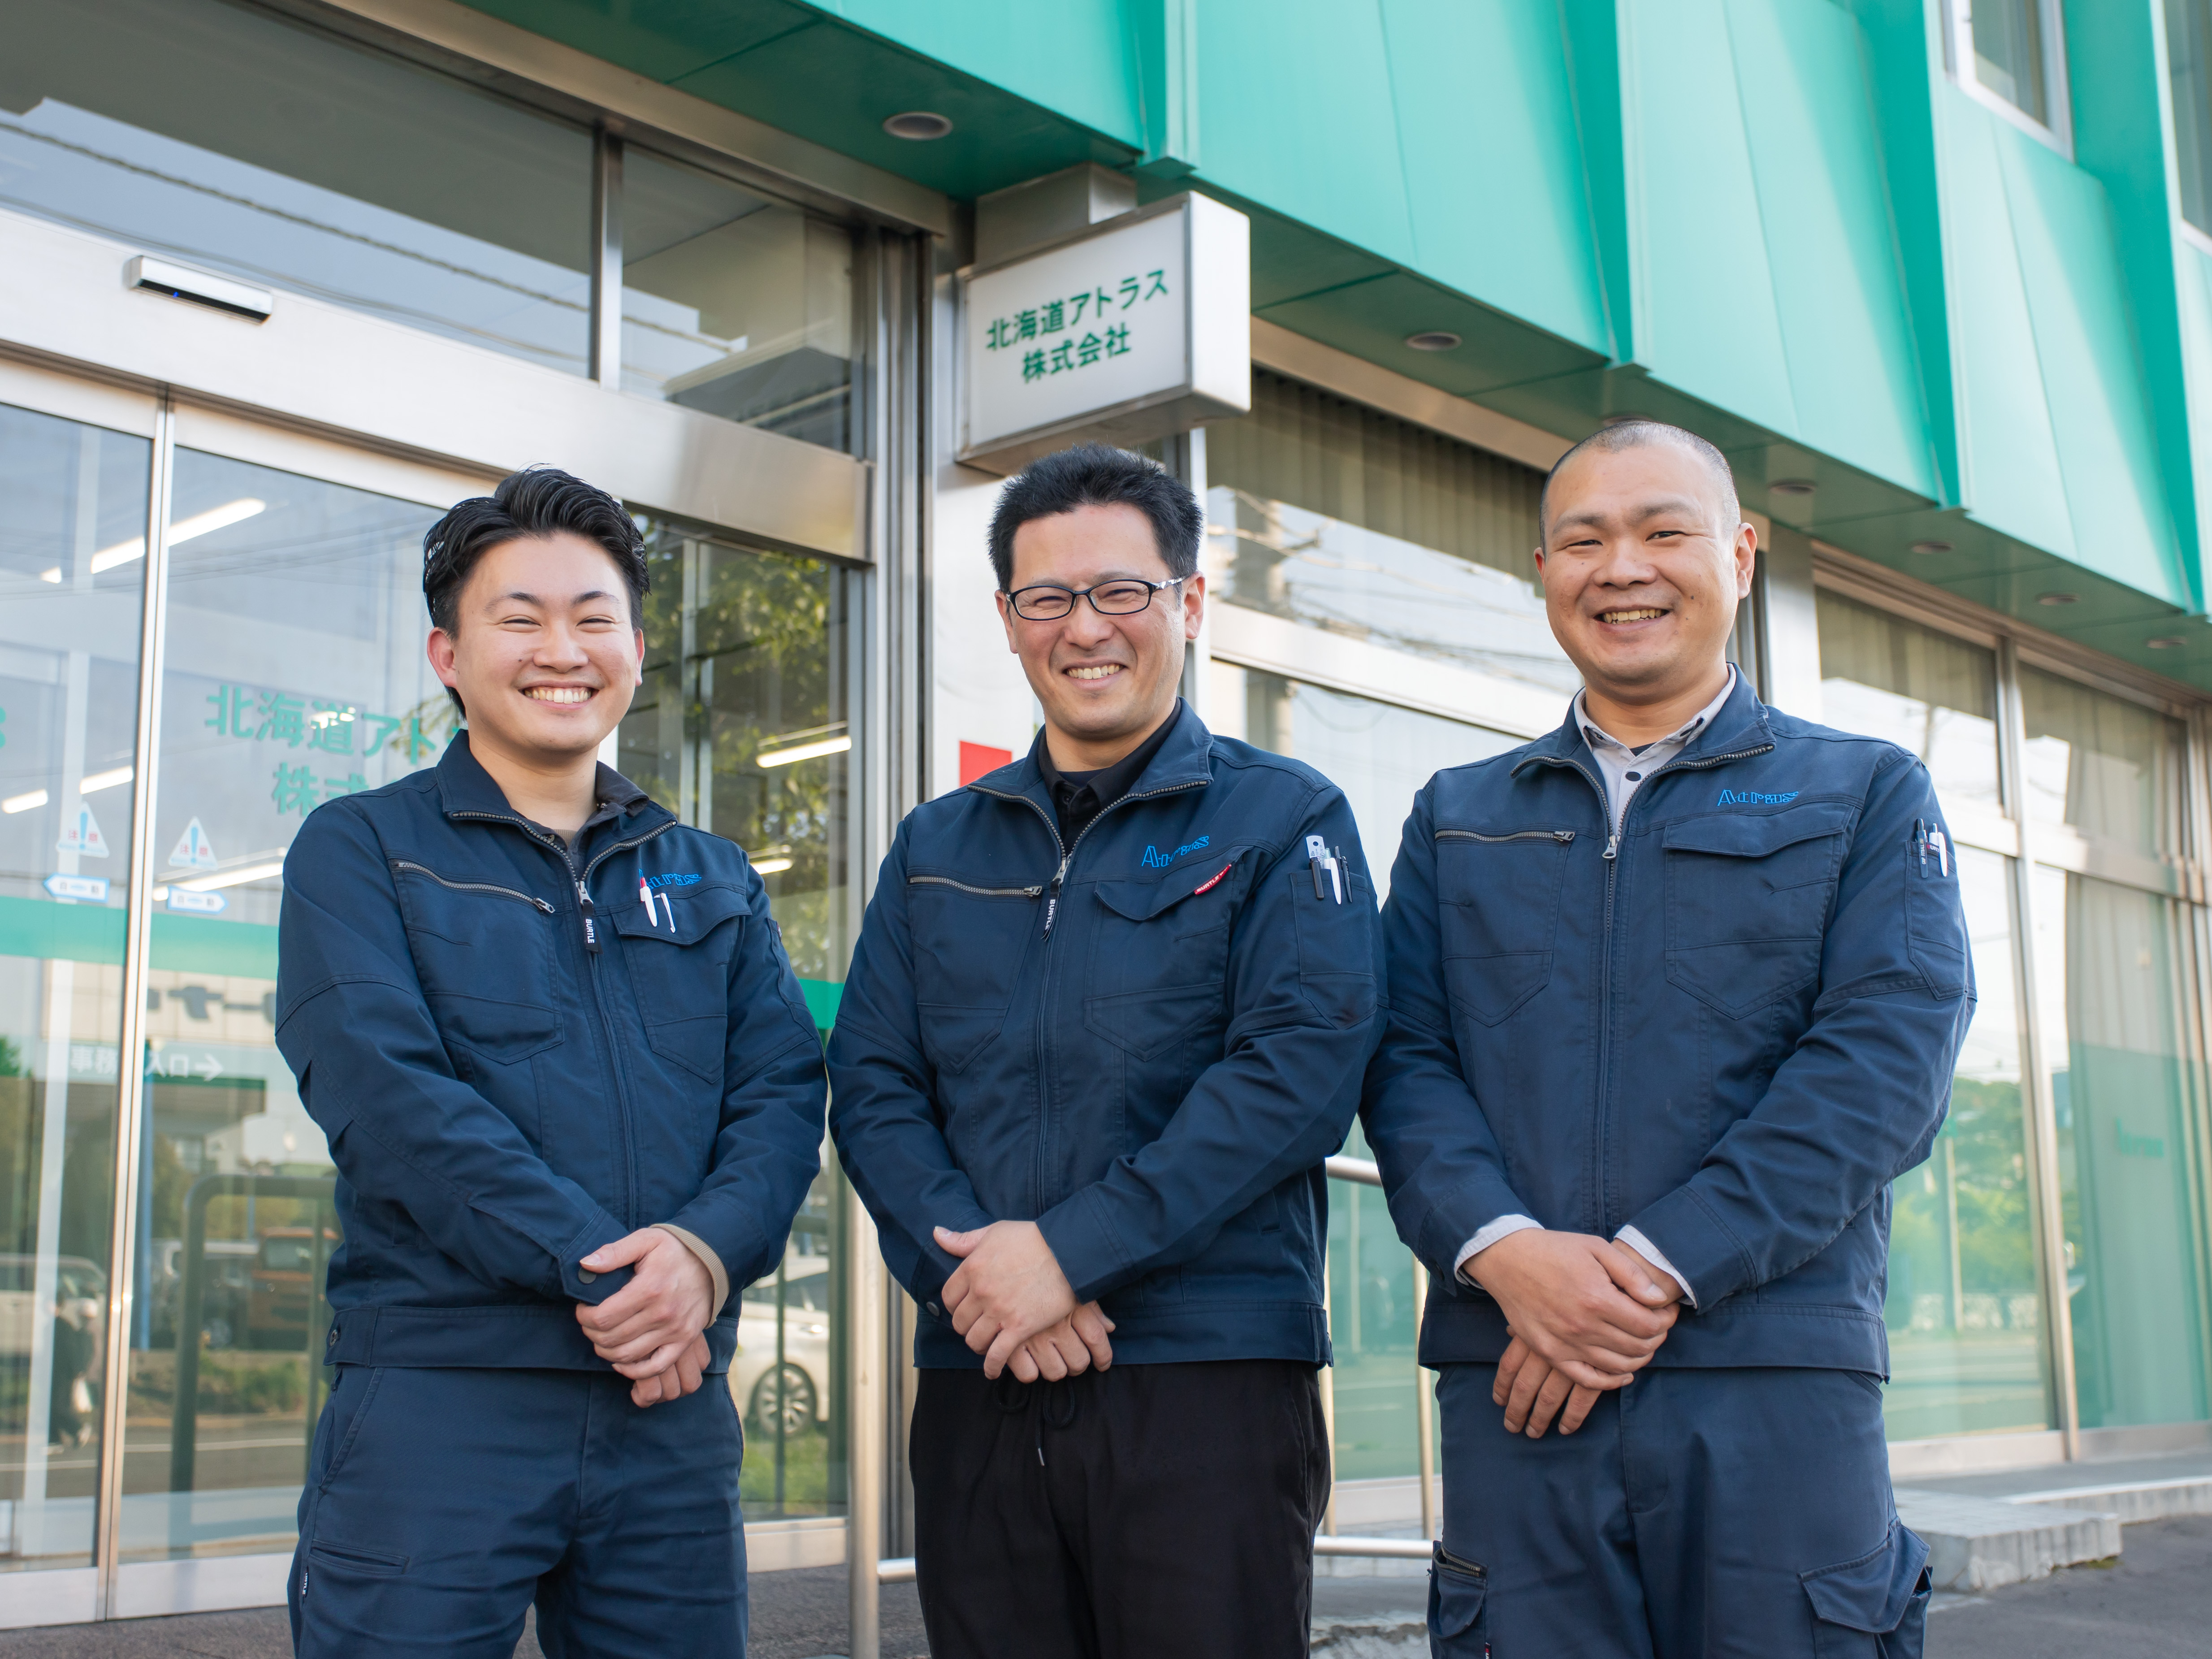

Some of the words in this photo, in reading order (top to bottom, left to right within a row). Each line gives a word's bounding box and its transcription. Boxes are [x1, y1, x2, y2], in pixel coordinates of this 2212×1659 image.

[986, 270, 1168, 351] 北海道アトラス
[1022, 322, 1131, 384] 株式会社
[205, 684, 464, 766] 北海道アト
[1196, 875, 1220, 892] BURTLE
[585, 918, 595, 944] BURTLE
[1045, 899, 1056, 931] BURTLE
